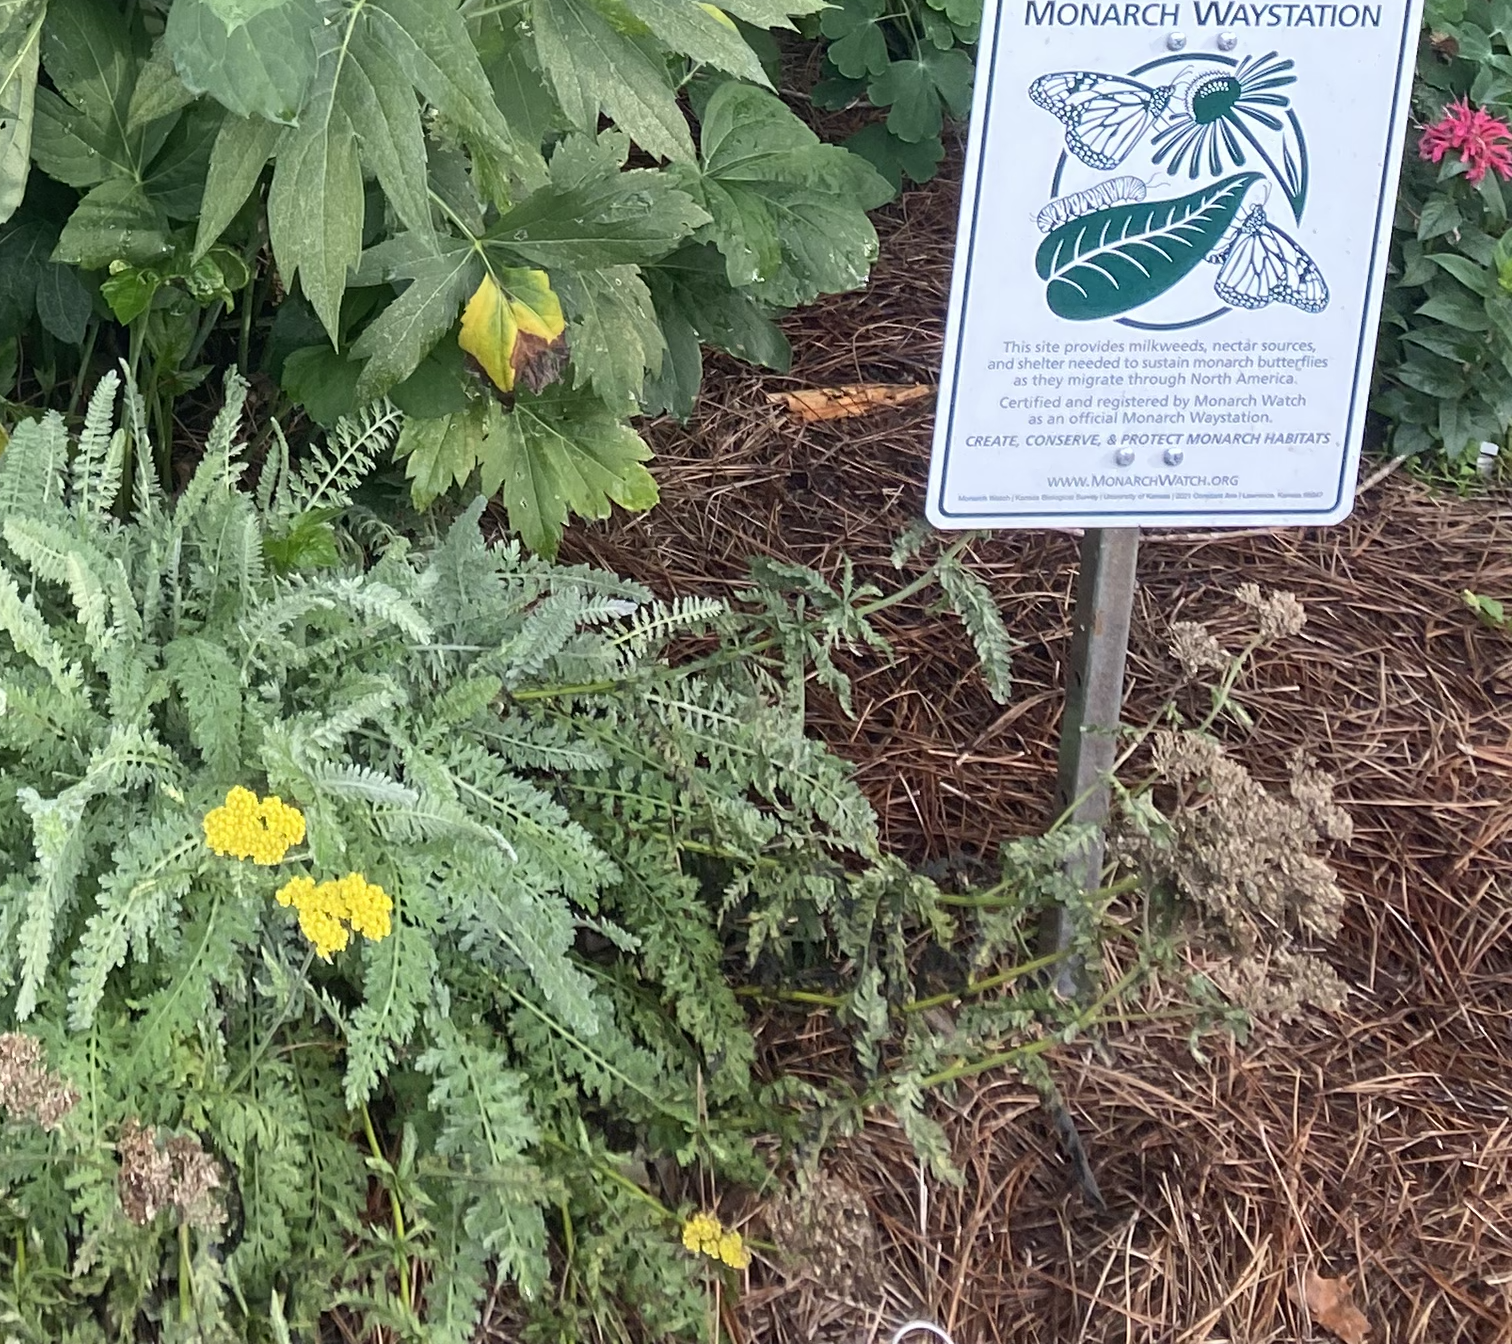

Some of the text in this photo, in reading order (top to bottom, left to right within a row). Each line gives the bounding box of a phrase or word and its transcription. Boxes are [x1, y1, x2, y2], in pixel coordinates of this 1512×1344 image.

[1003, 339, 1316, 355] This site provides milkweeds, nectar sources,
[988, 355, 1328, 370] and shelter needed to sustain monarch butterflies
[1014, 377, 1027, 386] as
[1032, 374, 1064, 389] they
[1068, 374, 1124, 388] migrate
[1128, 372, 1186, 388] through
[1191, 372, 1231, 385] North
[1000, 394, 1306, 410] Certified and registered by Monarch Watch
[1028, 411, 1272, 426] as an official Monarch Waystation.
[966, 432, 1331, 447] CREATE, CONSERVE, & PROTECT MONARCH HABITATS
